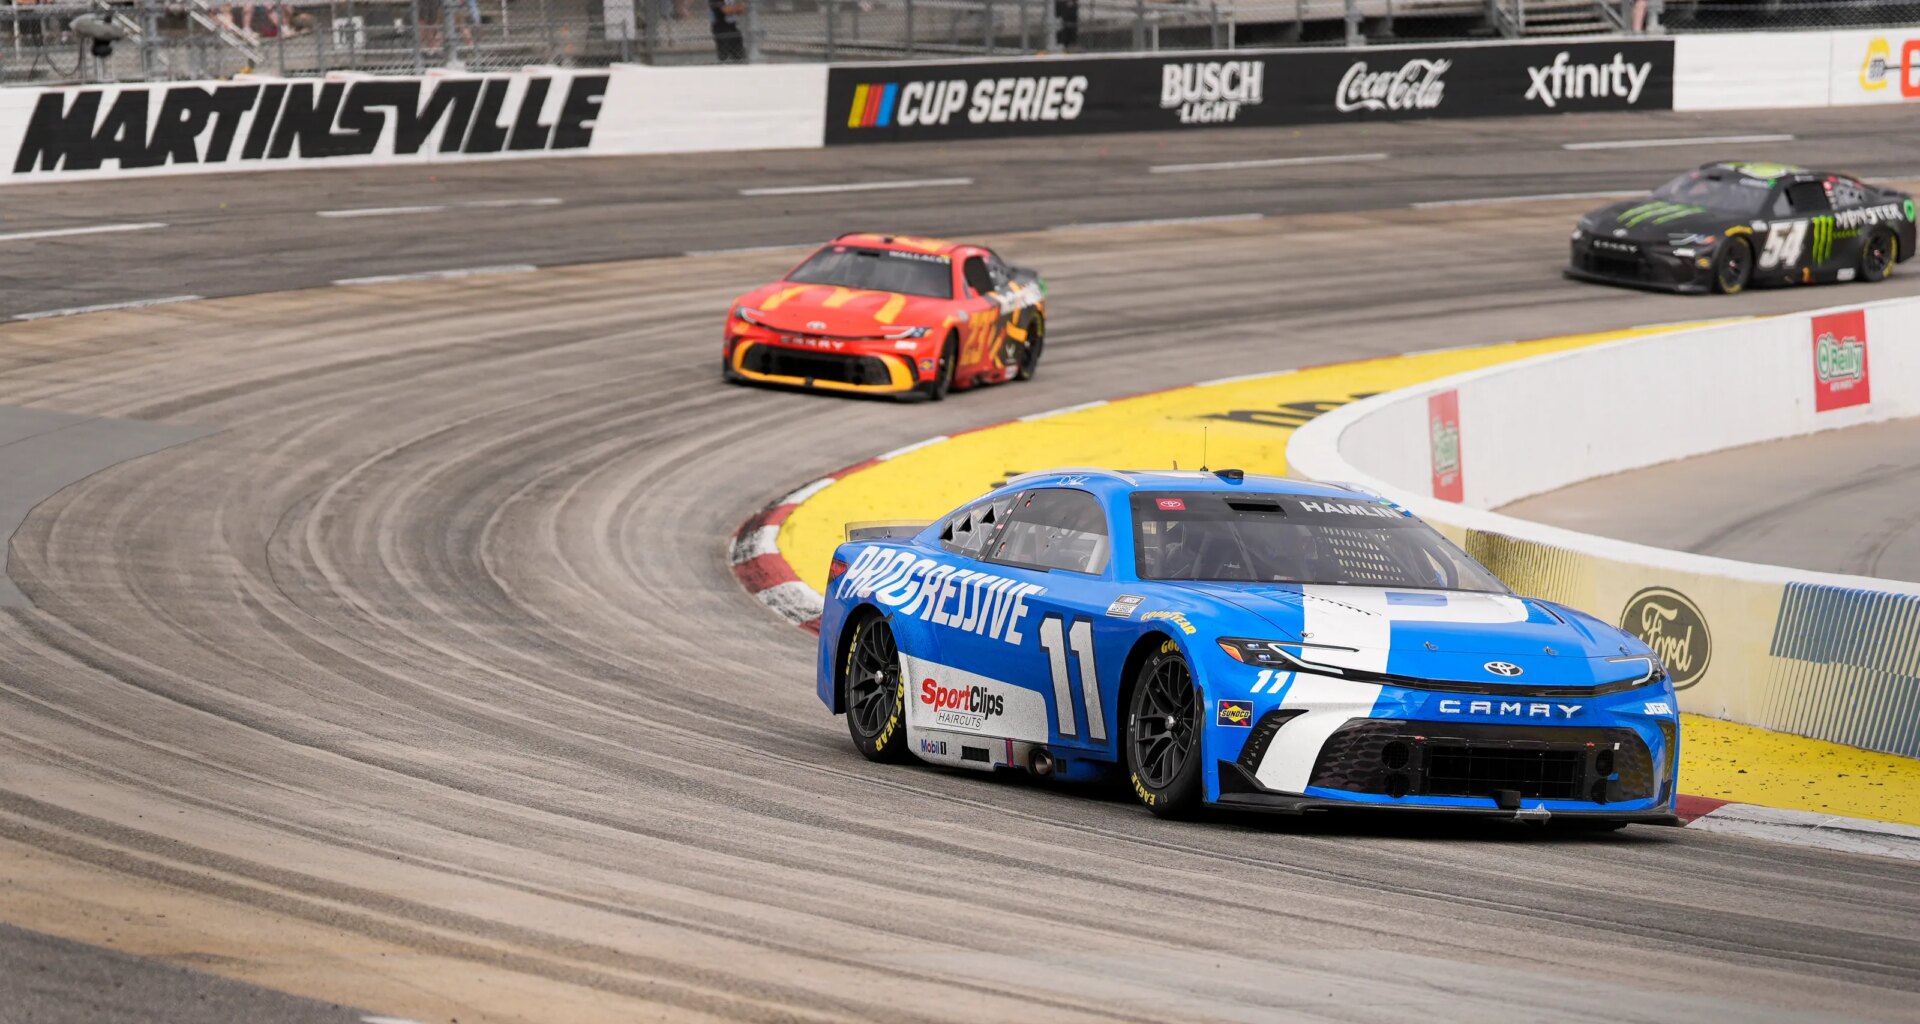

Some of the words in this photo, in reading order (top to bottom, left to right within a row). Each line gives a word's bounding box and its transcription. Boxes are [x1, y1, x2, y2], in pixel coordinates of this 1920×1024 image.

[1160, 60, 1264, 108] BUSCH
[1524, 51, 1652, 107] xfinity
[898, 80, 968, 126] CUP
[968, 76, 1088, 124] SERIES
[1180, 100, 1240, 123] LIGHT
[13, 75, 609, 173] MARTINSVILLE
[1759, 220, 1808, 268] 54
[1299, 501, 1404, 519] HAMLIN
[834, 545, 1045, 646] PROGRESSIVE
[1639, 602, 1694, 672] Ford
[1039, 616, 1108, 742] 11
[1250, 669, 1291, 694] 11
[938, 712, 982, 728] HAIRCUTS
[1220, 709, 1251, 719] SUNOCO
[1439, 700, 1583, 719] CAMRY
[1644, 702, 1673, 716] JGR
[920, 738, 940, 754] Mobil
[1131, 771, 1156, 806] EAGLE
